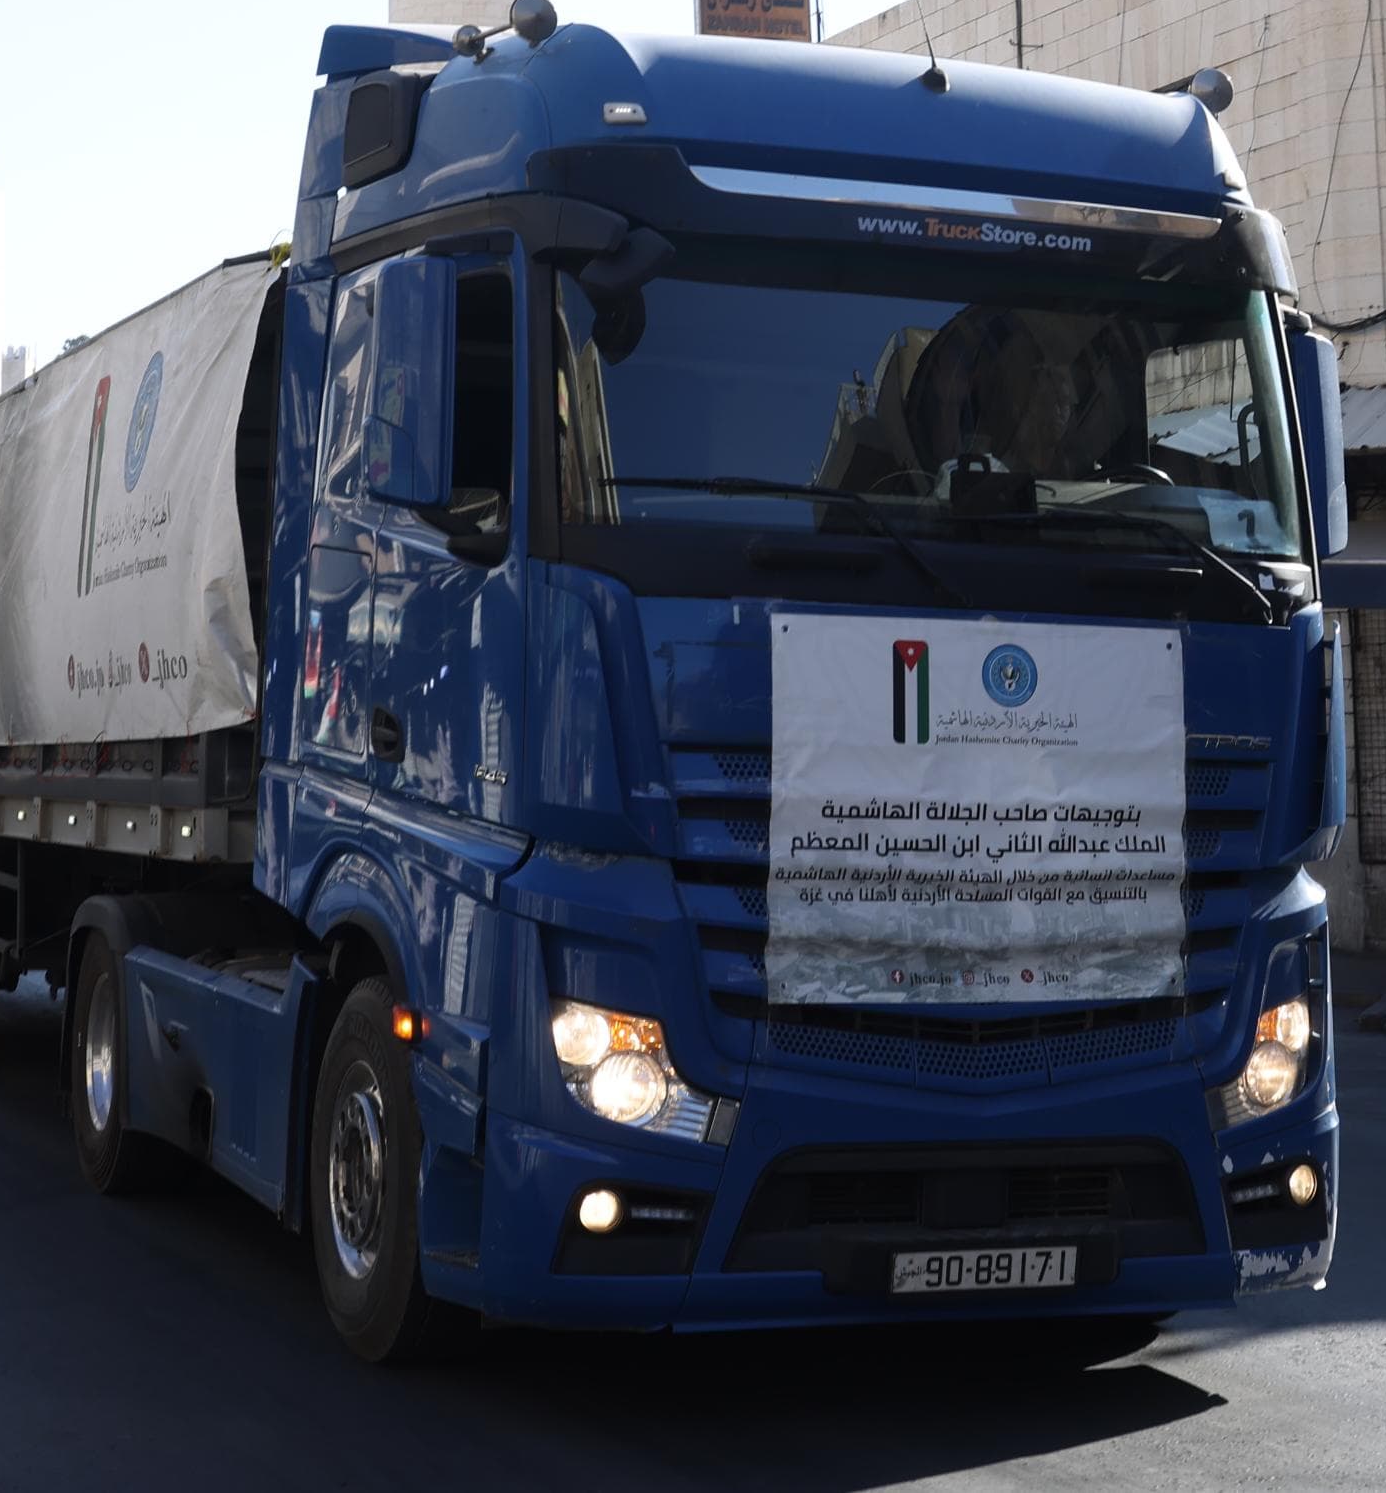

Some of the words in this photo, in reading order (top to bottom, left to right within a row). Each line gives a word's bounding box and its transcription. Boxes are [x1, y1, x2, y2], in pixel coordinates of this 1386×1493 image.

[857, 216, 1091, 252] www.TruckStore.com
[152, 649, 187, 690] _jhco
[935, 734, 959, 745] Jordan
[961, 734, 1001, 745] Hashemite
[1002, 735, 1029, 747] Charity
[1031, 737, 1078, 748] Organization
[821, 797, 920, 824] الهاشمية
[926, 802, 987, 826] الجلالة
[993, 803, 1047, 826] صاحب
[1054, 804, 1141, 827] بتوجيهات
[790, 831, 869, 858] المعظم
[876, 834, 946, 857] الحسين
[953, 834, 980, 857] ابن
[986, 831, 1041, 863] الثاني
[1048, 828, 1110, 858] عبدالله
[1115, 835, 1166, 853] الملك
[775, 866, 847, 884] الهاشمية
[851, 864, 902, 885] الأردنية
[905, 868, 955, 885] الخيرية
[959, 869, 1003, 886] الهيئة
[1006, 869, 1035, 885] خلال
[1038, 871, 1059, 884] من
[1063, 869, 1113, 883] انسانية
[1115, 869, 1175, 882] مساعدات
[799, 887, 823, 905] غزة
[828, 888, 854, 905] في
[859, 884, 897, 902] لأهلنا
[901, 885, 950, 906] الأردنية
[955, 887, 1013, 903] المسلحة
[1017, 887, 1061, 905] القوات
[1066, 892, 1085, 904] مع
[1089, 886, 1147, 904] بالتنسيق
[909, 972, 952, 986] jhco.jo
[926, 1250, 1066, 1287] 90-89171
